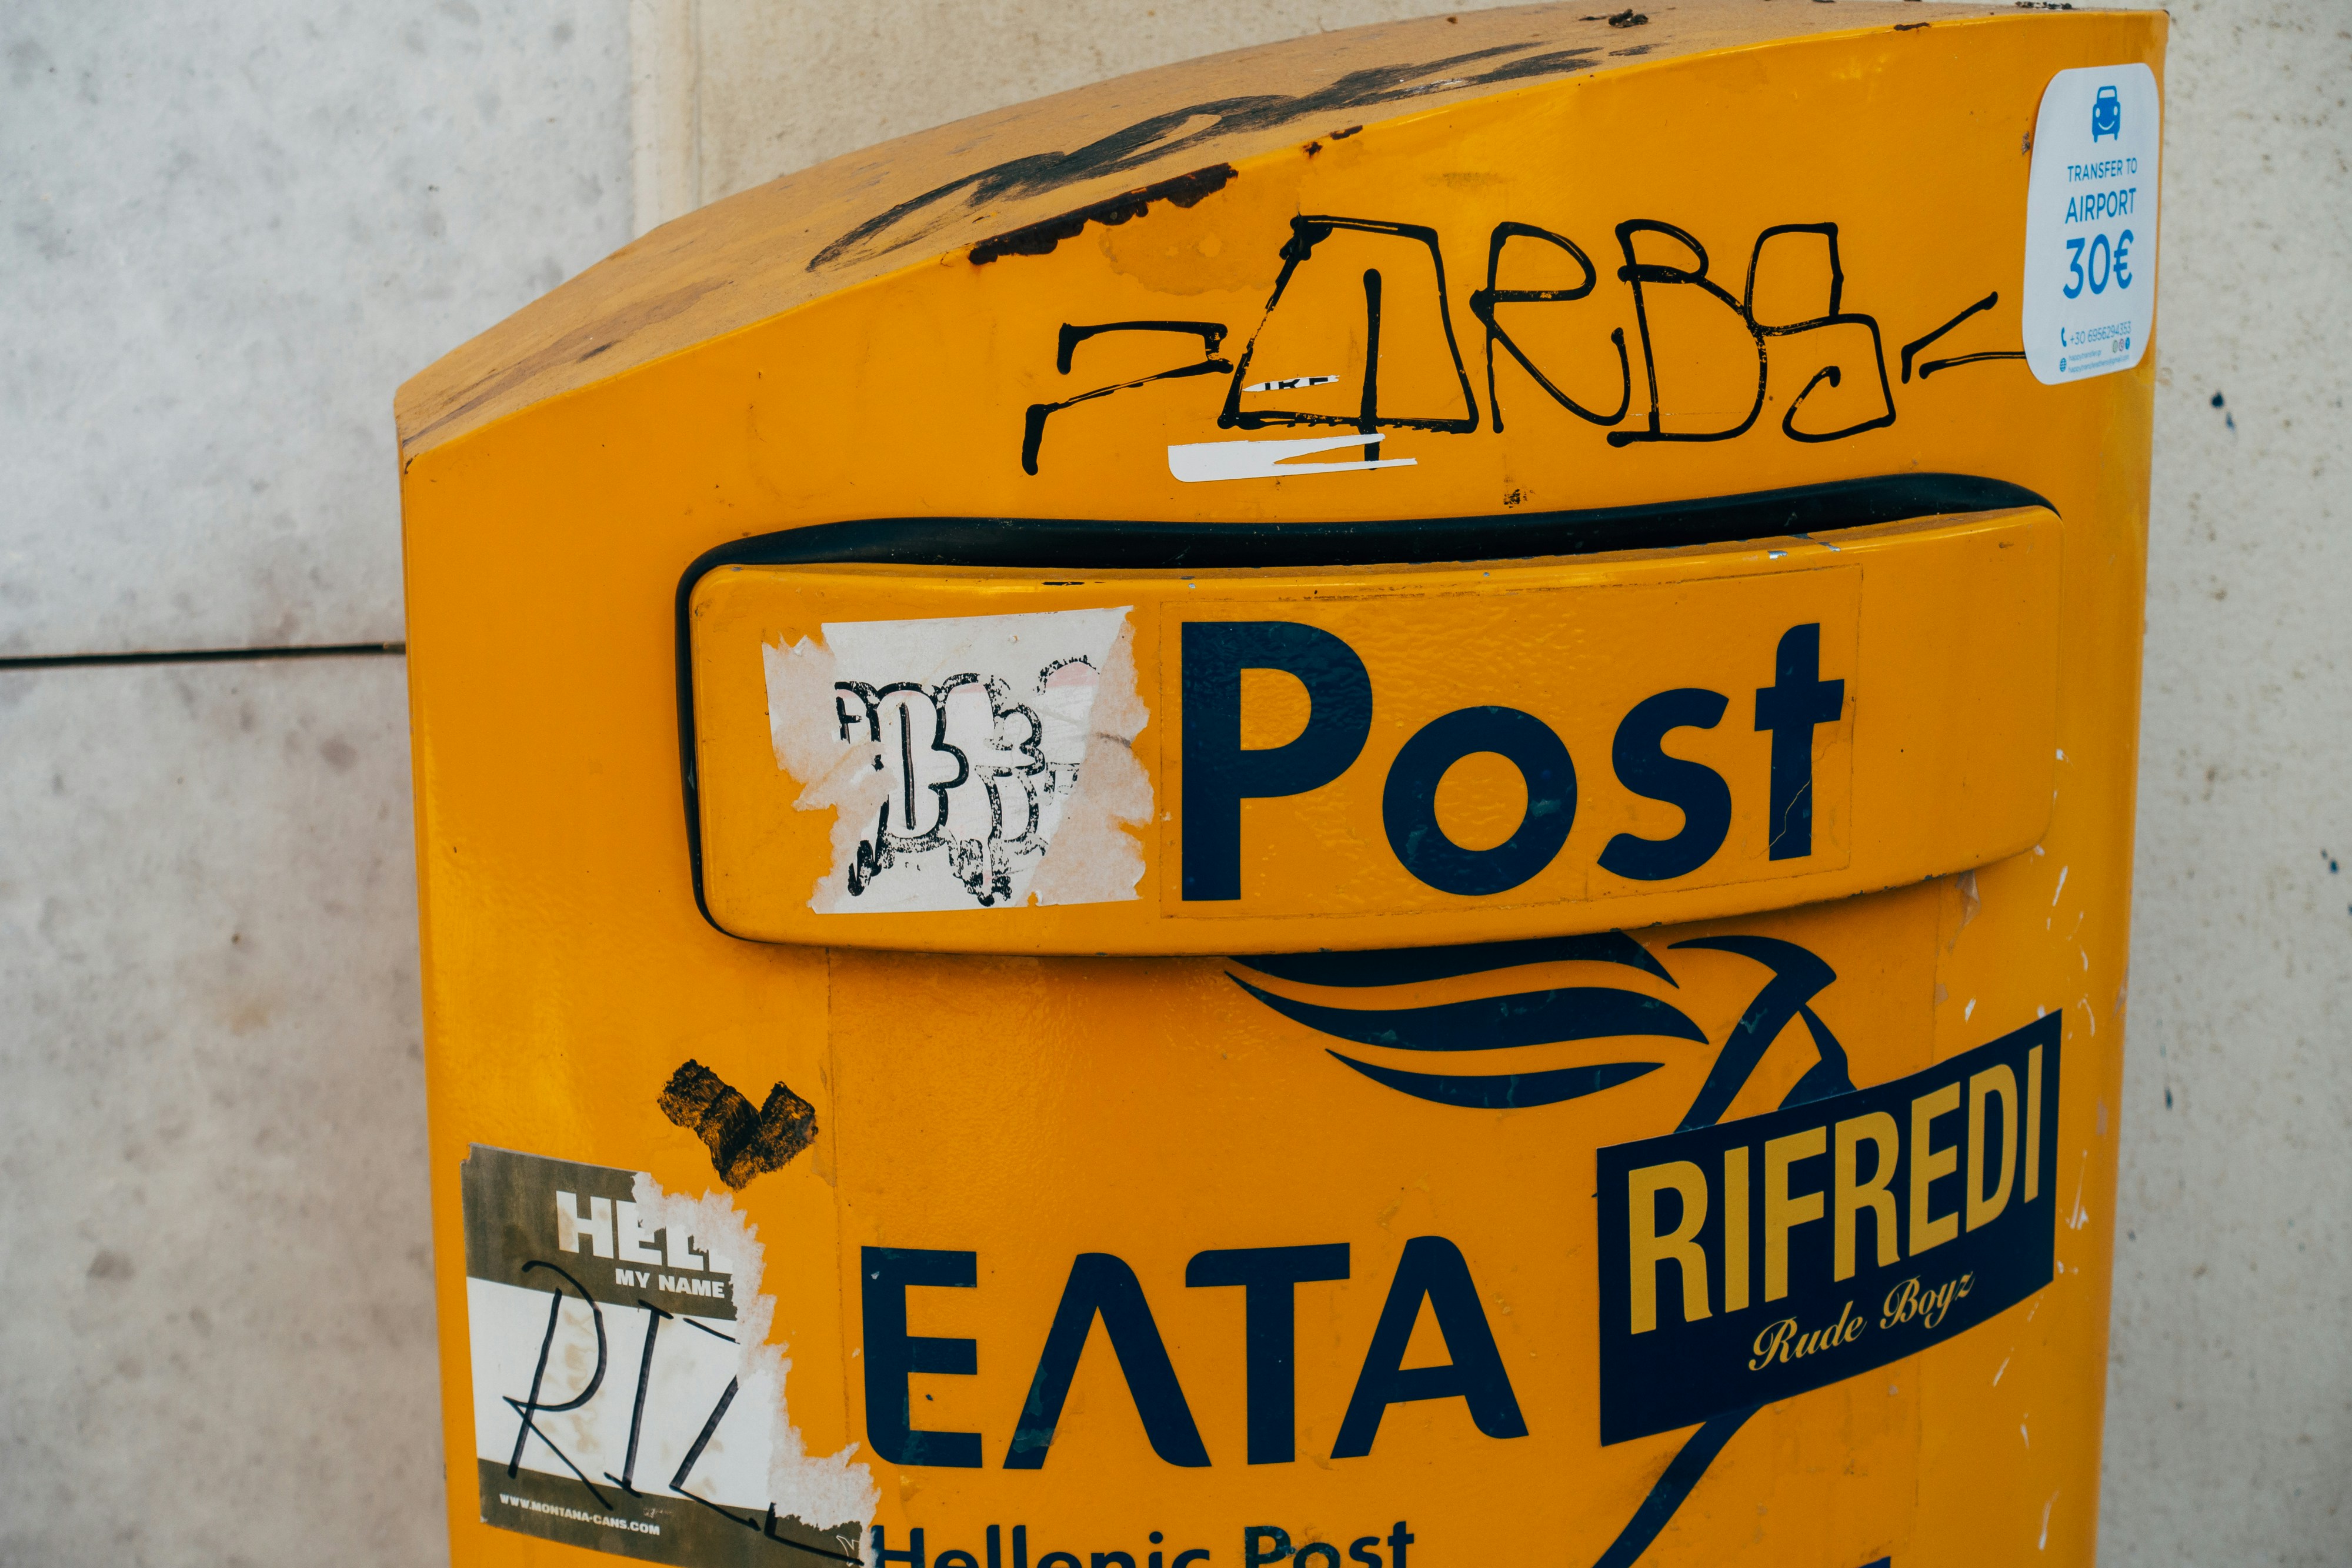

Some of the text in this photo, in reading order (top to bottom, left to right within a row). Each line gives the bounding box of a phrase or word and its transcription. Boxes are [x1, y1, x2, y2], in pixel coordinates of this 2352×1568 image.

[2067, 157, 2138, 182] TRANSFER TO
[2065, 187, 2136, 224] AIRPORT
[2063, 229, 2134, 299] 30€
[2070, 331, 2086, 345] +30
[1182, 620, 1845, 901] Post
[1629, 1043, 2043, 1335] RIFREDI
[615, 1268, 725, 1299] MY NAME
[1748, 1270, 1976, 1371] Rude Boyz
[499, 1493, 660, 1536] WWW.MONTANA-CANS.COM
